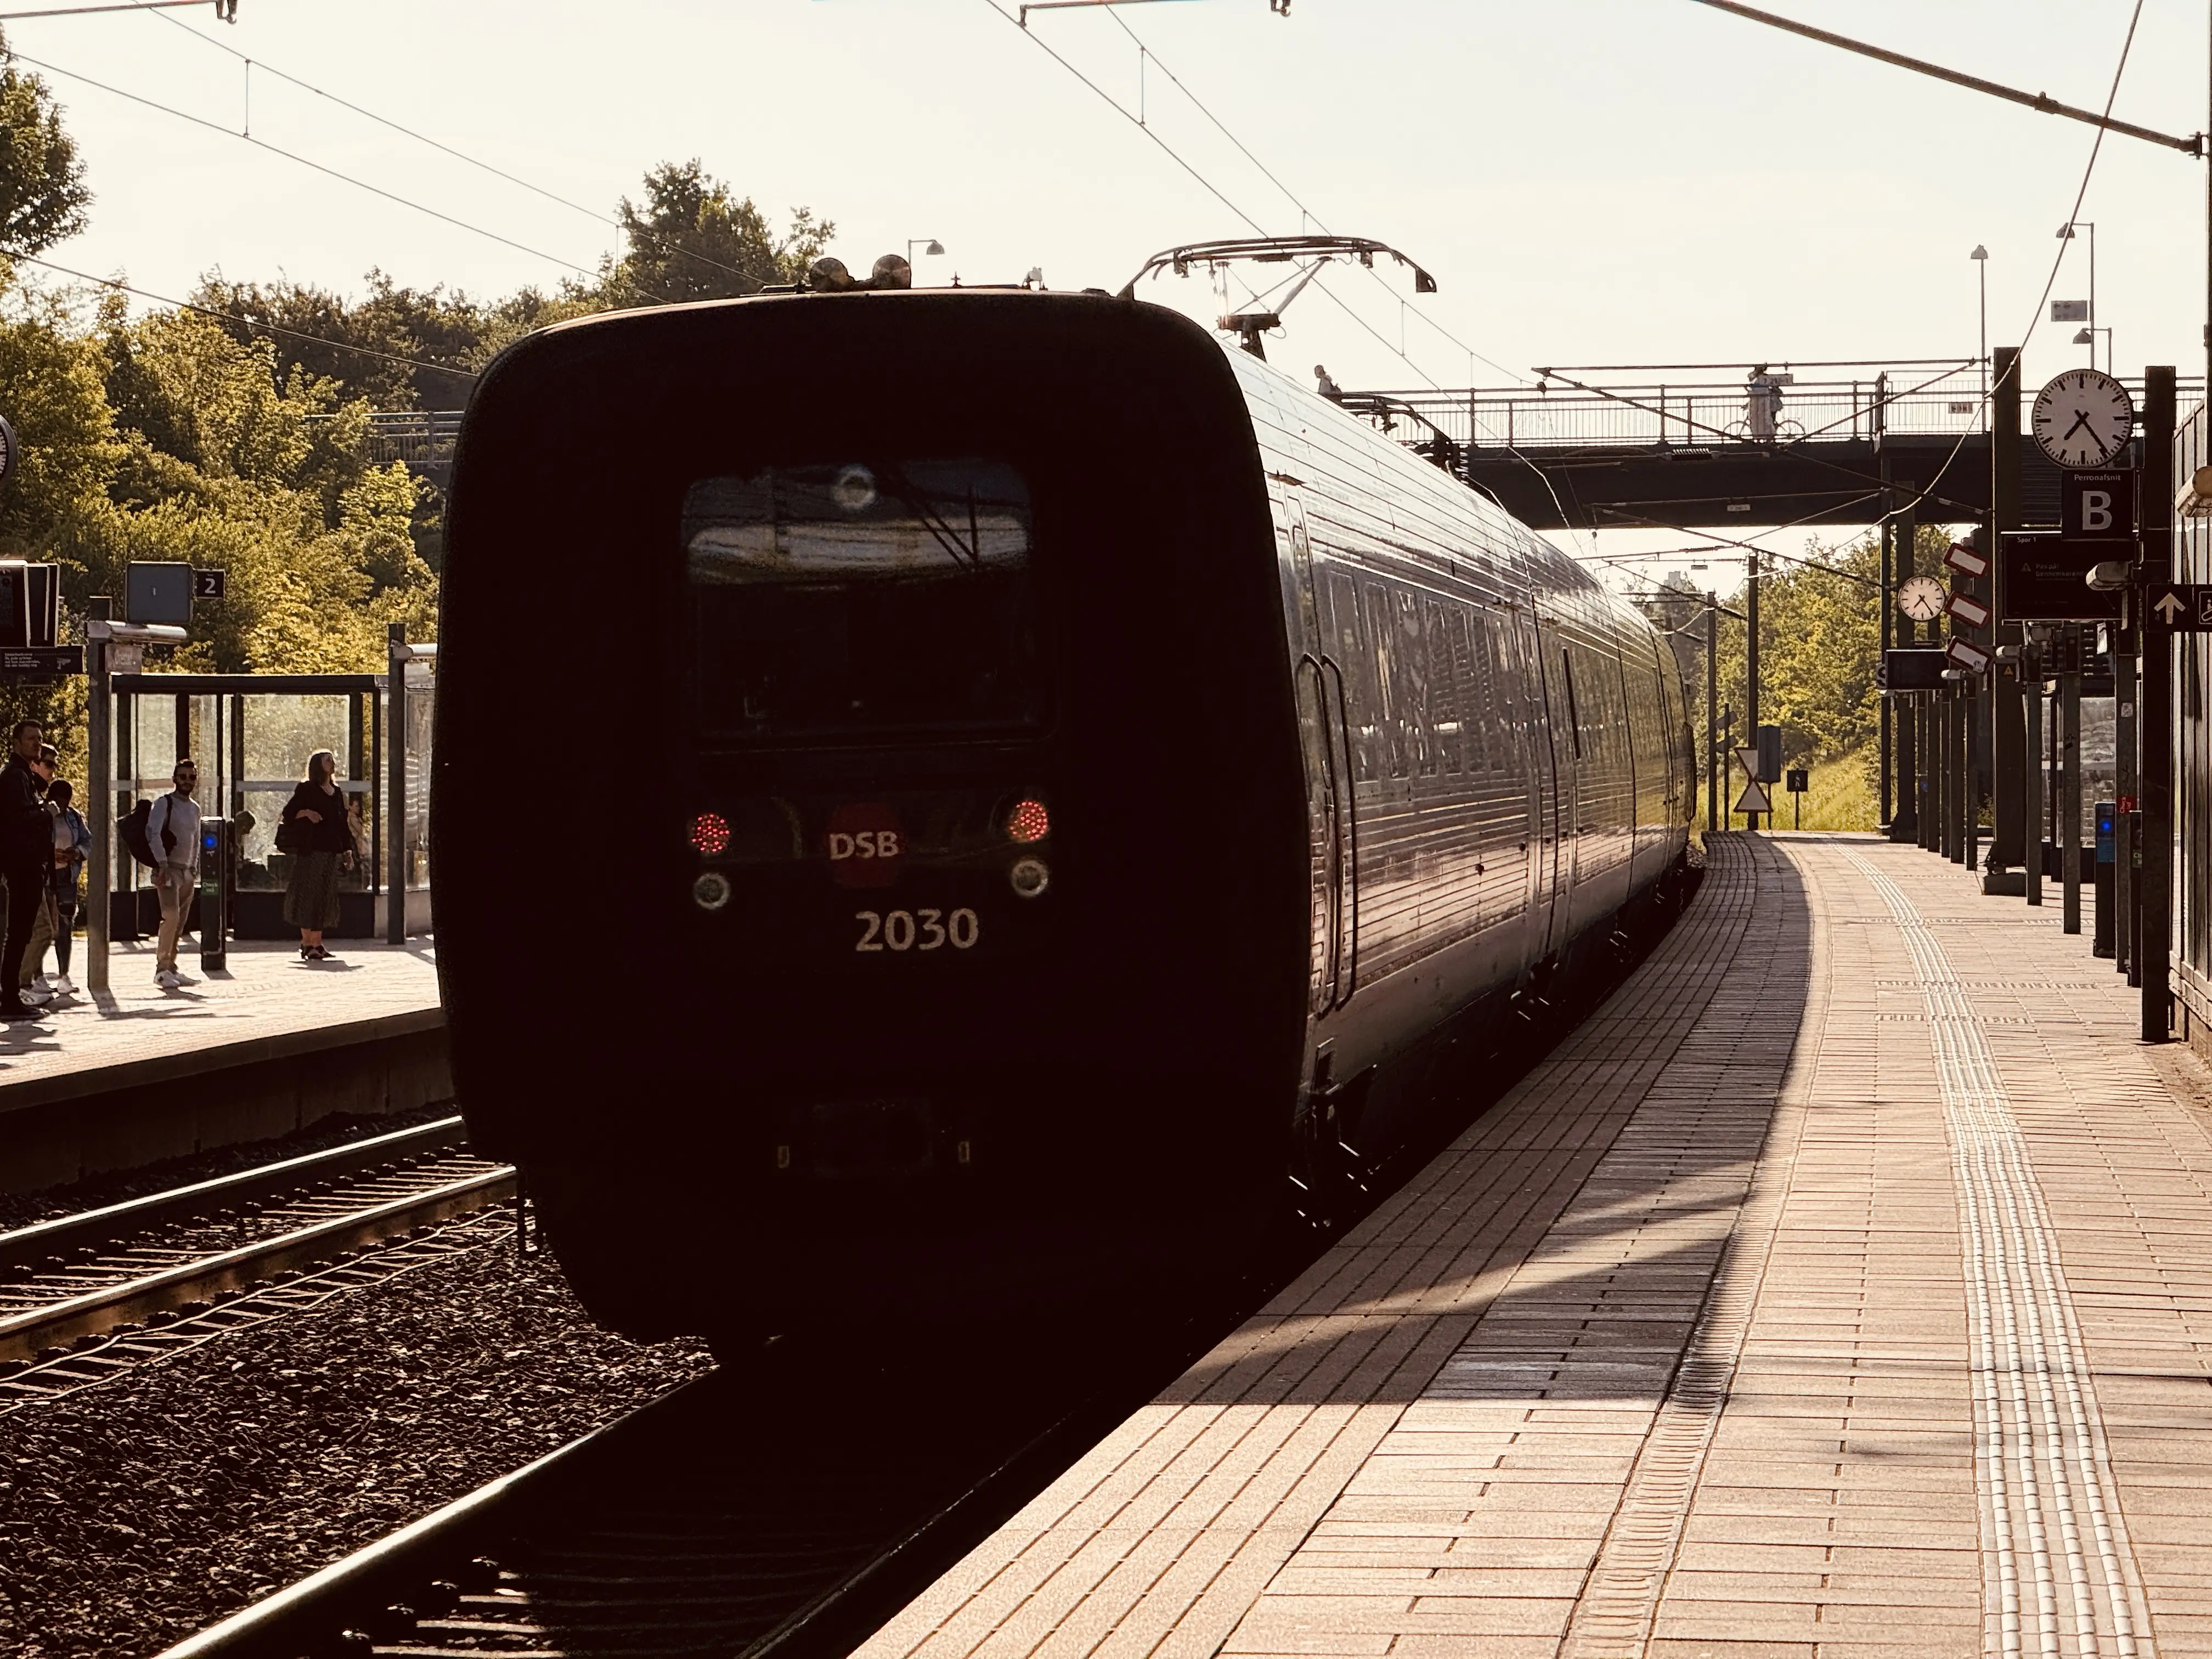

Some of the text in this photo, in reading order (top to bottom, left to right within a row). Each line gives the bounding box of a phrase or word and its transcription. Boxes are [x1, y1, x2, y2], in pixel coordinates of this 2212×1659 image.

[2083, 491, 2113, 530] B
[205, 578, 216, 594] 2
[829, 831, 900, 860] DSB
[855, 907, 979, 952] 2030
